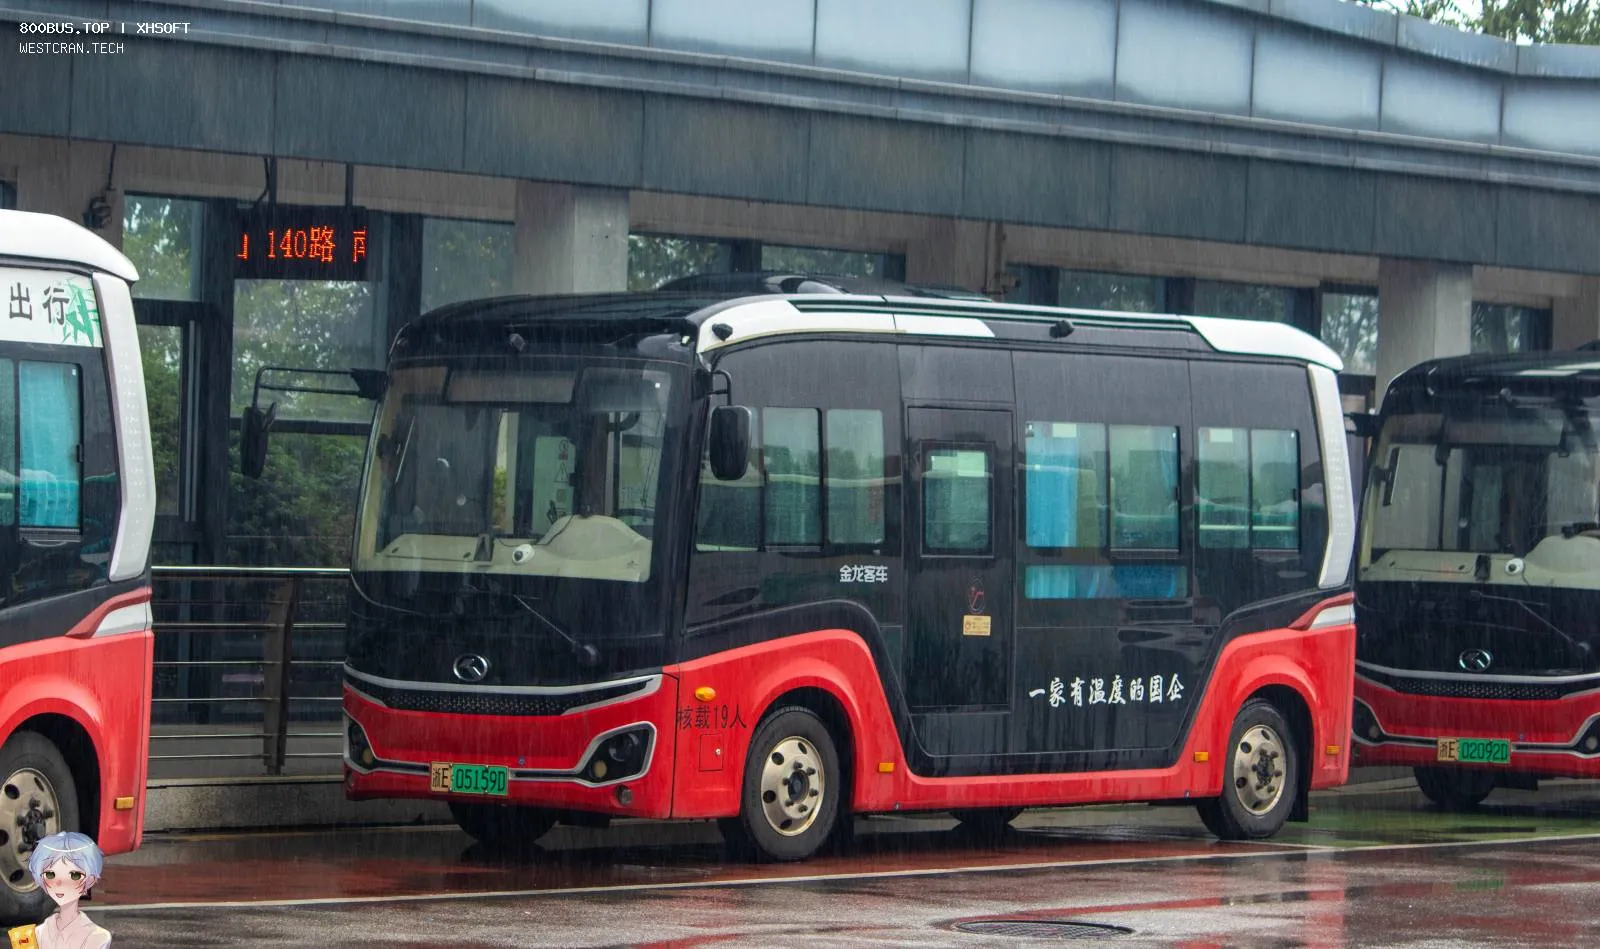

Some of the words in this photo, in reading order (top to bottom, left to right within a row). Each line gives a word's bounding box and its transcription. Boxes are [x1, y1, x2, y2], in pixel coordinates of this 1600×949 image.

[267, 225, 336, 263] 140路
[9, 281, 70, 326] 出行
[839, 564, 889, 583] 金龙客车
[1028, 672, 1185, 708] 一家有温度的国企
[677, 703, 747, 731] 核载19人
